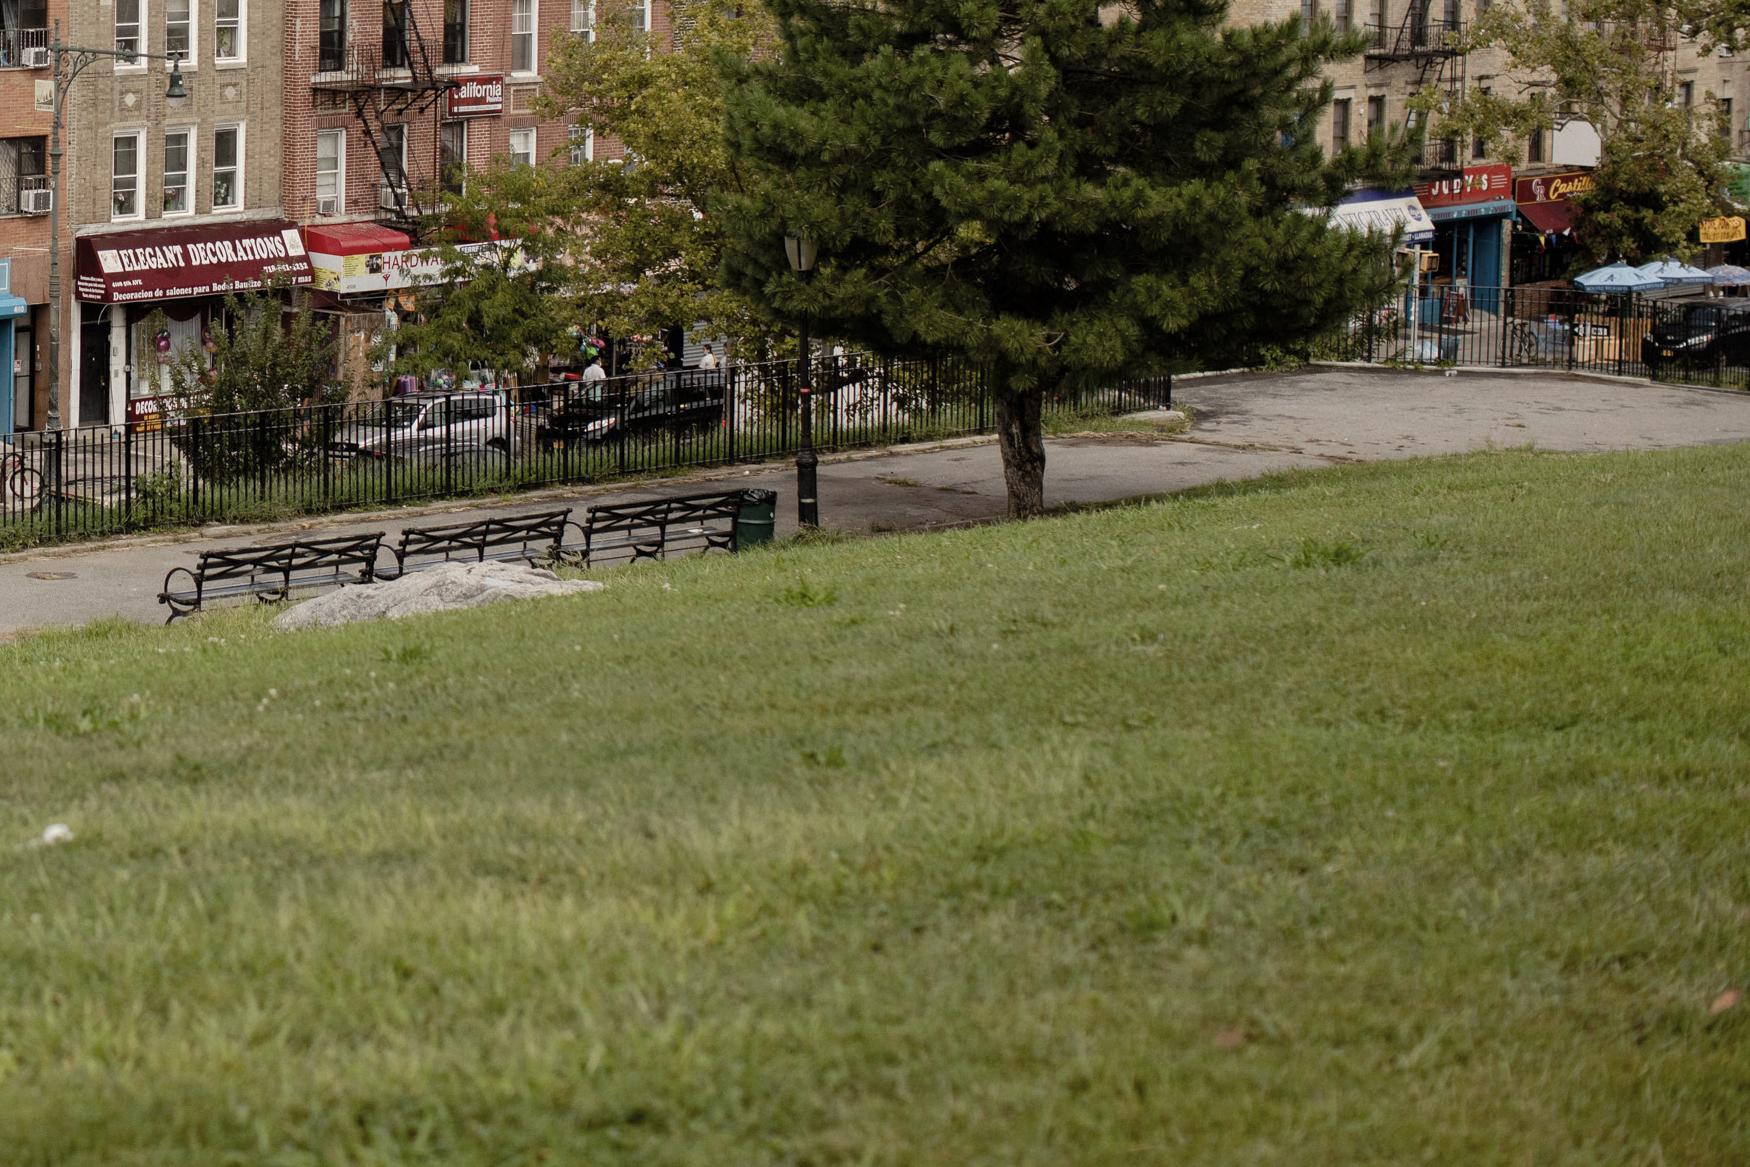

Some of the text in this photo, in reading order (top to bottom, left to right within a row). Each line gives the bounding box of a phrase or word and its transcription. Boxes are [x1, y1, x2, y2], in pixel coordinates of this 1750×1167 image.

[1431, 173, 1488, 196] JUDYS
[119, 236, 286, 272] ELEGANT DECORATIONS
[113, 290, 154, 301] Decoracion
[154, 288, 163, 297] de
[166, 286, 192, 296] salones
[193, 284, 210, 295] para
[212, 281, 234, 292] Bods
[291, 275, 297, 285] y
[297, 275, 312, 283] mas
